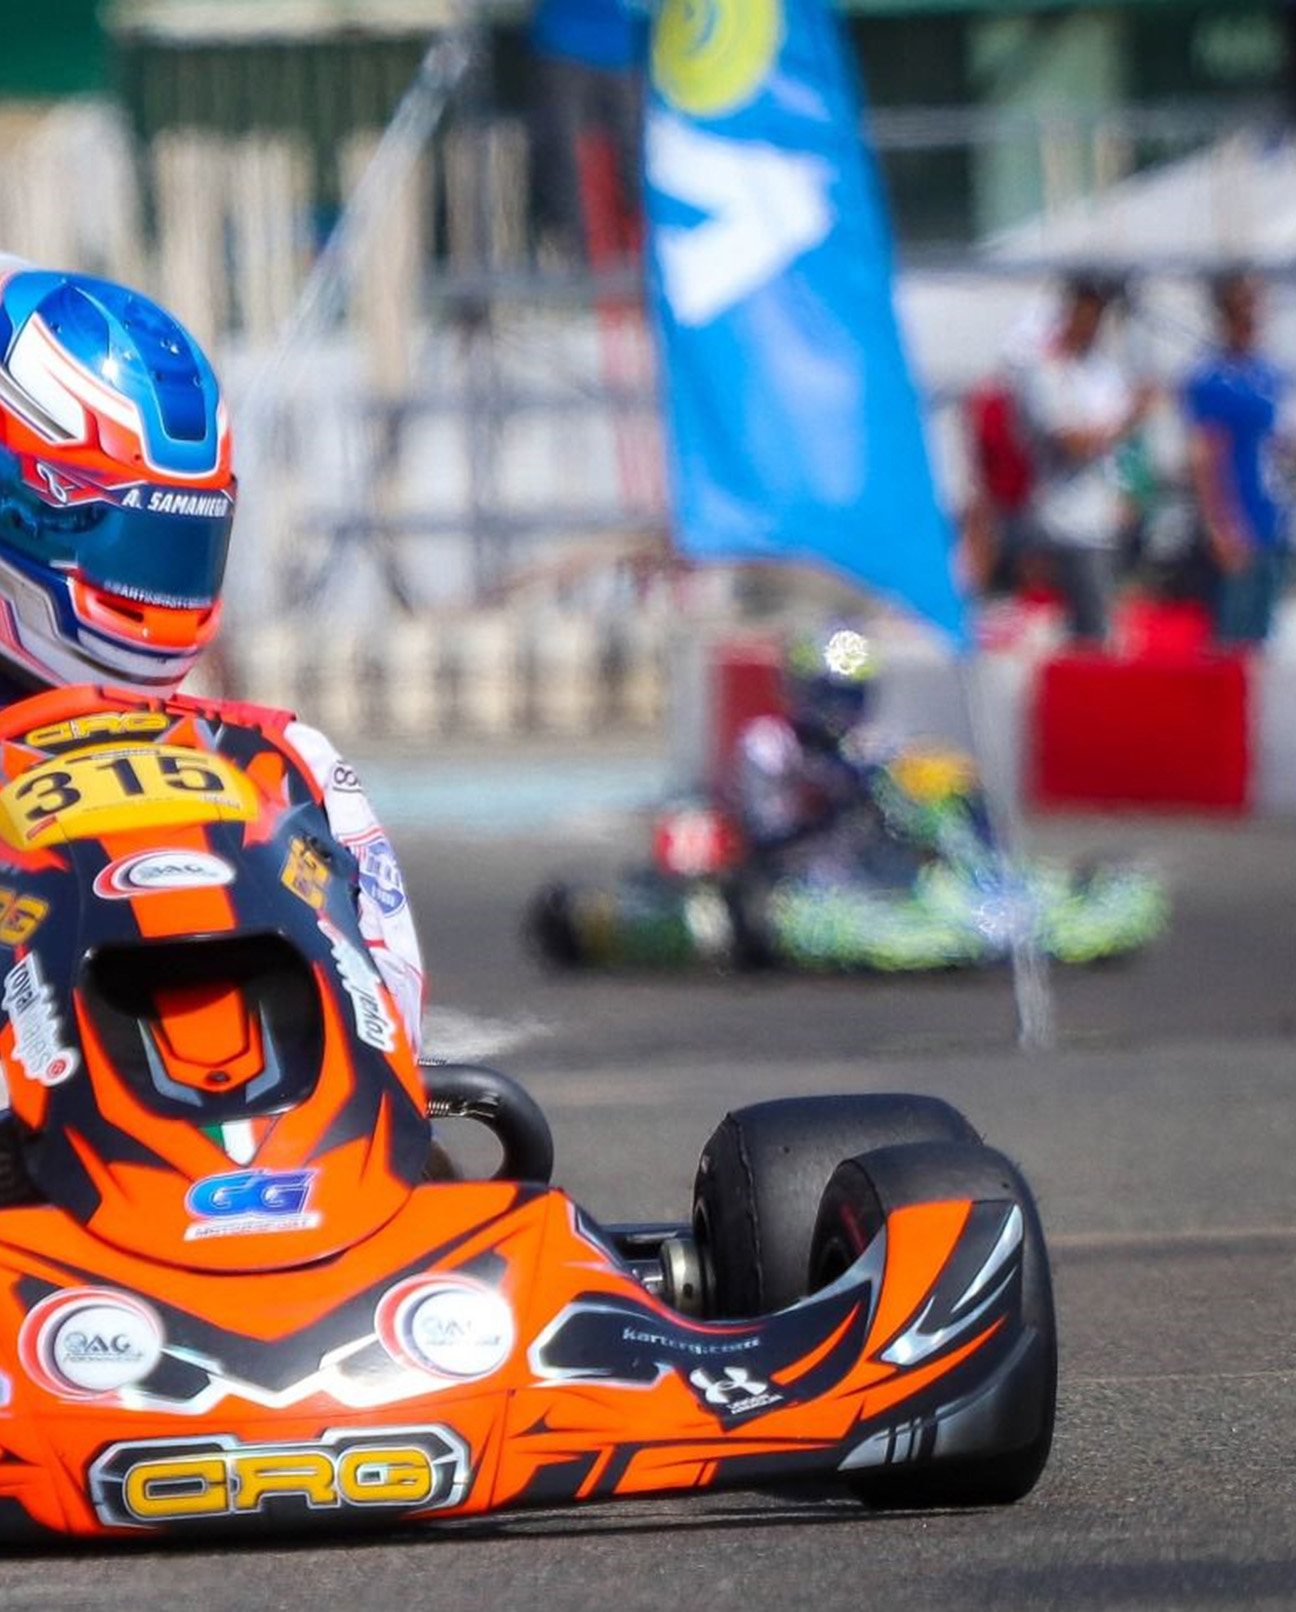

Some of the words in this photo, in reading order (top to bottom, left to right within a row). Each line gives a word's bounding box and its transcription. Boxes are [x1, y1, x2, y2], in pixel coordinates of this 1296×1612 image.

[121, 488, 143, 509] A.
[15, 756, 225, 821] 315
[123, 1447, 438, 1521] CRG
